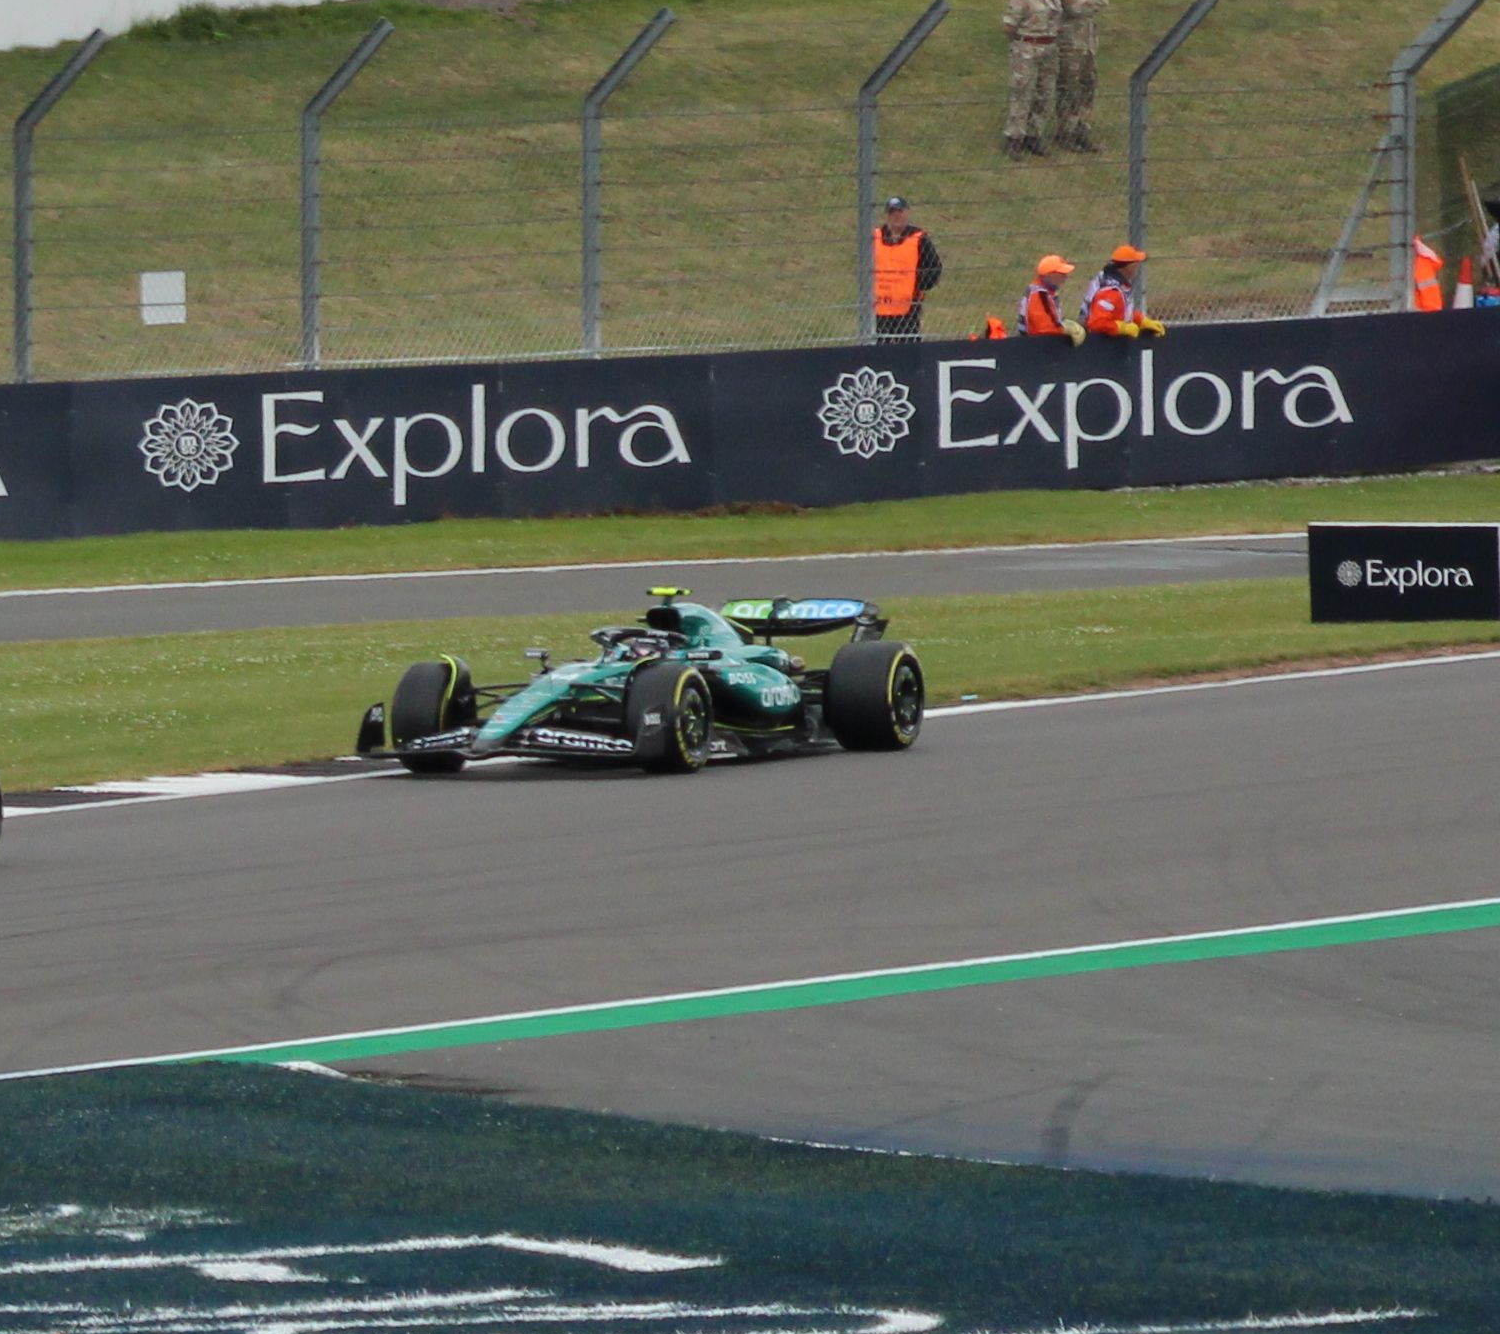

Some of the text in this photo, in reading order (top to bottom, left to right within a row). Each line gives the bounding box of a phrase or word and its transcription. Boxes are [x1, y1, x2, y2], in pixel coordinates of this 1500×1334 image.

[262, 384, 691, 505] Explora
[937, 349, 1353, 469] Explora
[1366, 559, 1473, 594] Explora
